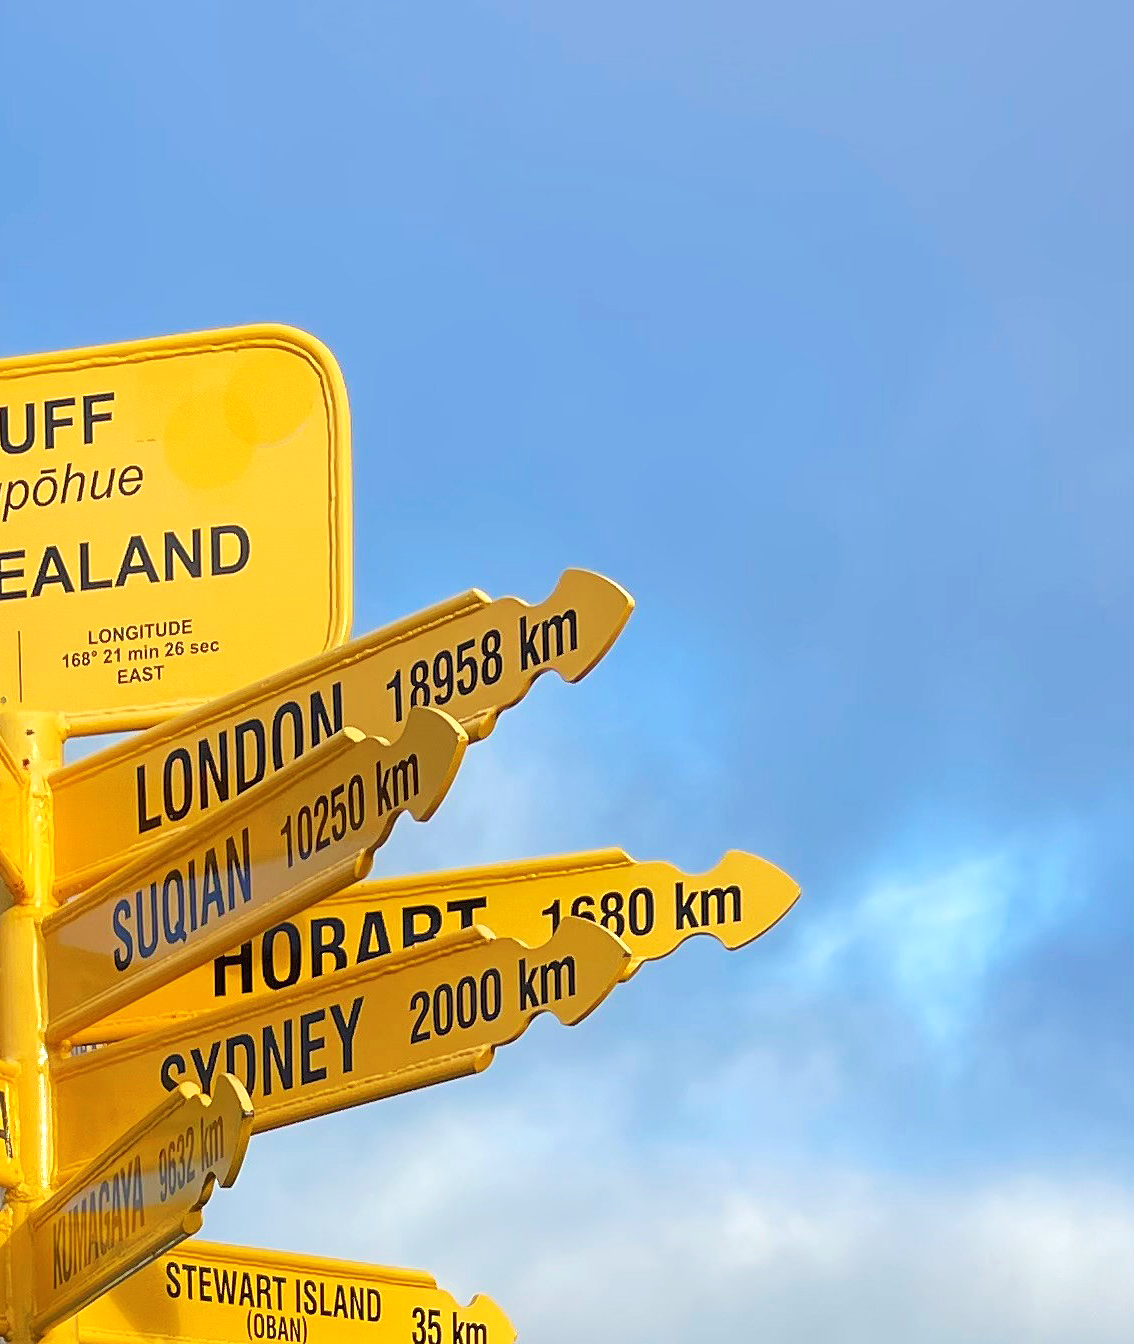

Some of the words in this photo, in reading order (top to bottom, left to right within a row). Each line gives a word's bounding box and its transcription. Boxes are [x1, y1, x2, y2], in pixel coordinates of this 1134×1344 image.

[62, 650, 98, 668] 168°
[103, 647, 121, 664] 21
[128, 645, 159, 661] min
[165, 641, 184, 657] 26
[190, 640, 219, 654] sec
[88, 619, 193, 645] LONGITUDE
[117, 665, 165, 684] EAST
[136, 681, 343, 834] LONDON
[386, 637, 503, 723] 18958
[519, 607, 578, 672] km
[112, 828, 252, 972] SUQIAN
[279, 774, 365, 868] 10250
[376, 753, 419, 817] km
[214, 896, 487, 997] HOBART
[541, 887, 654, 938] 1680
[675, 881, 742, 930] km
[160, 996, 364, 1096] SYDNEY
[409, 967, 503, 1045] 2000
[519, 951, 577, 1013] km
[52, 1154, 145, 1290] KUMAGAYA
[158, 1127, 196, 1203] 9632
[200, 1115, 225, 1172] km
[166, 1261, 286, 1312] STEWART
[296, 1279, 382, 1322] ISLAND
